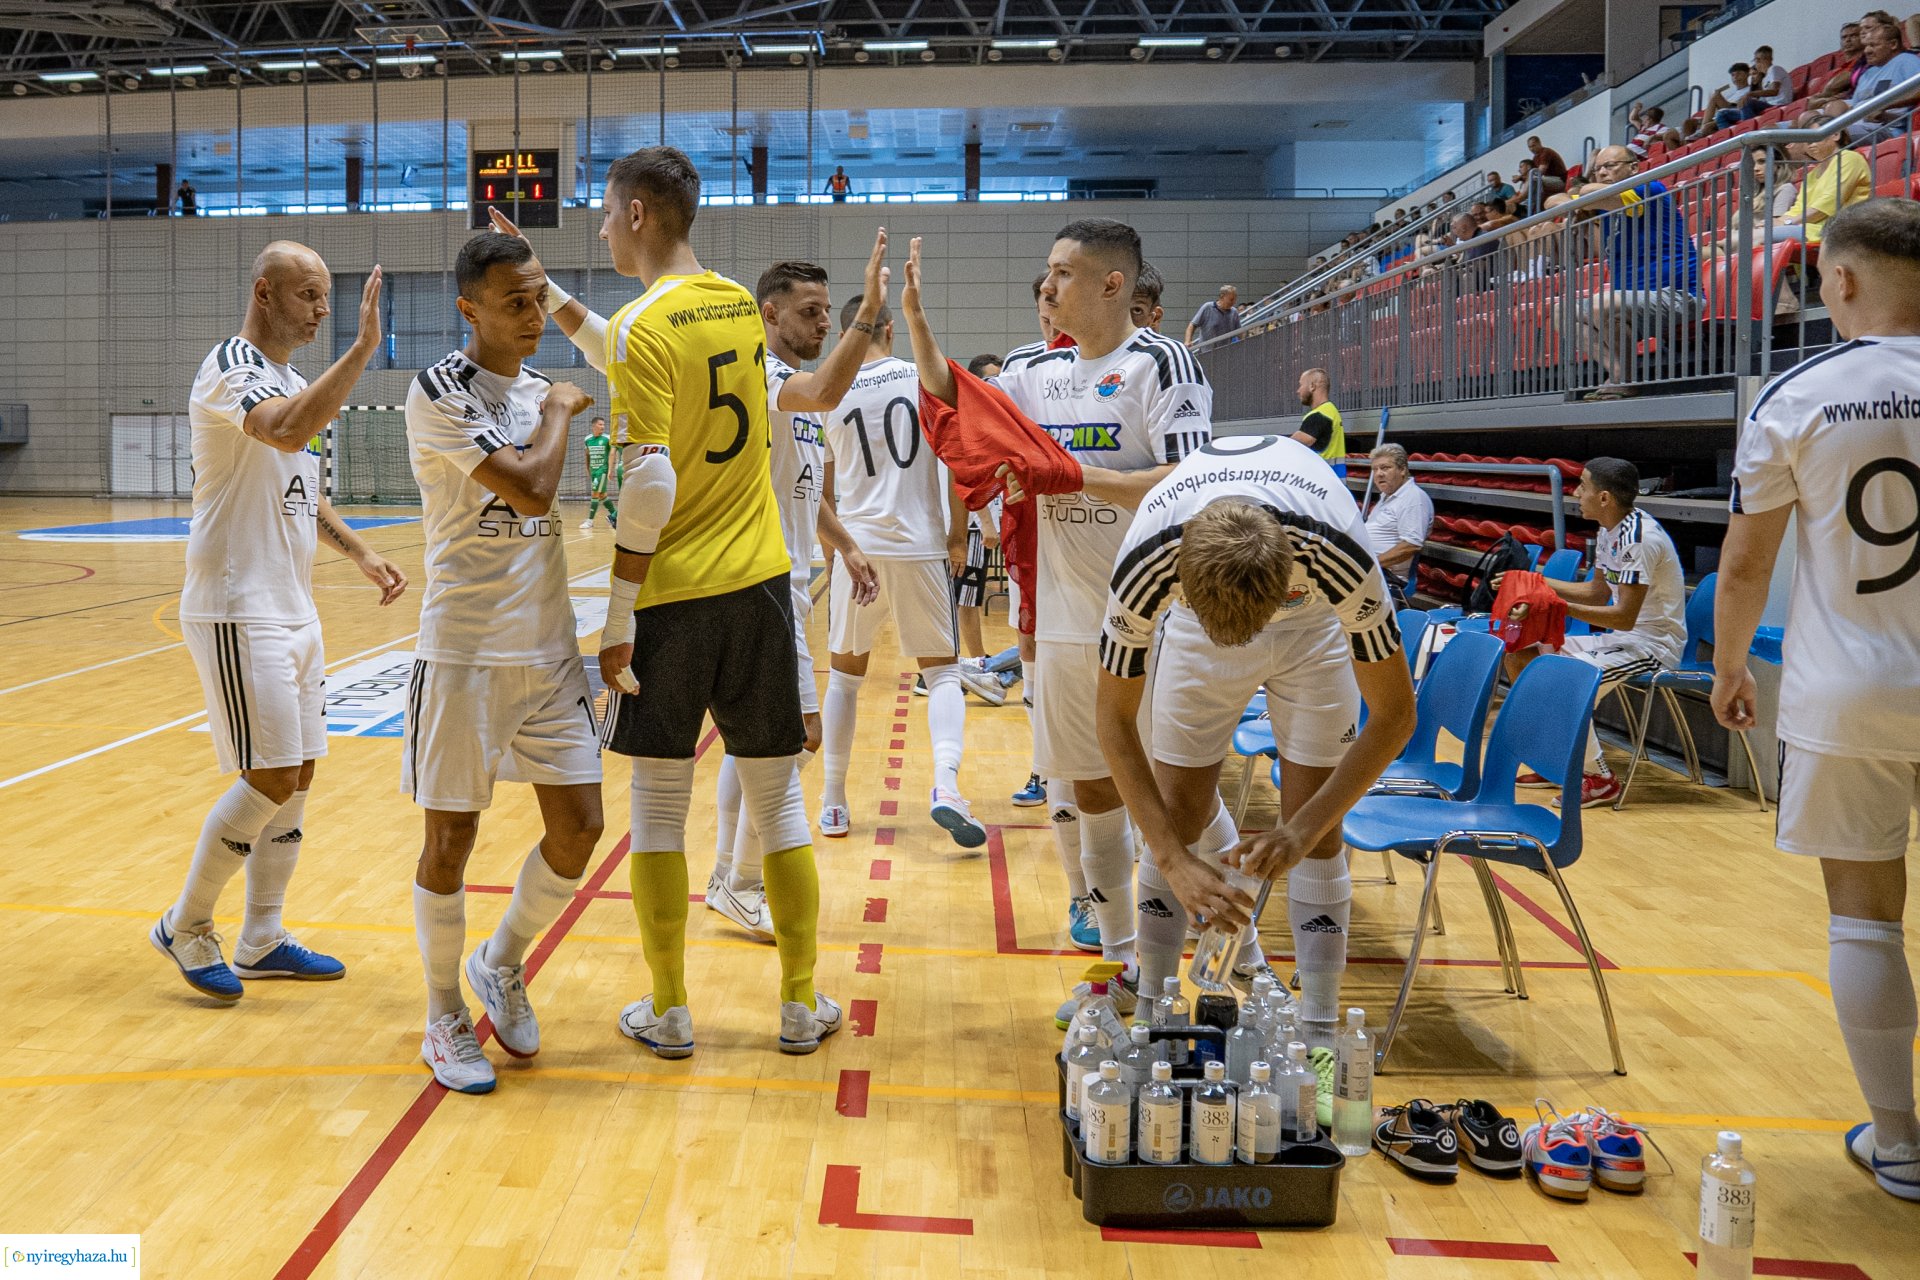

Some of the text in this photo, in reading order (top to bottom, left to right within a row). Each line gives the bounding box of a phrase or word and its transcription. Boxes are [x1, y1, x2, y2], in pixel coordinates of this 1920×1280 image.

[1043, 377, 1070, 401] 383
[1173, 410, 1201, 419] adidas
[843, 396, 920, 477] 10
[1147, 467, 1328, 513] www.raktarsportbolt.hu
[1042, 504, 1117, 525] STUDIO
[1845, 457, 1920, 594] 9
[1301, 924, 1343, 934] adidas
[1202, 1110, 1229, 1126] 383
[1201, 1186, 1273, 1209] JAKO
[1717, 1186, 1750, 1206] 383
